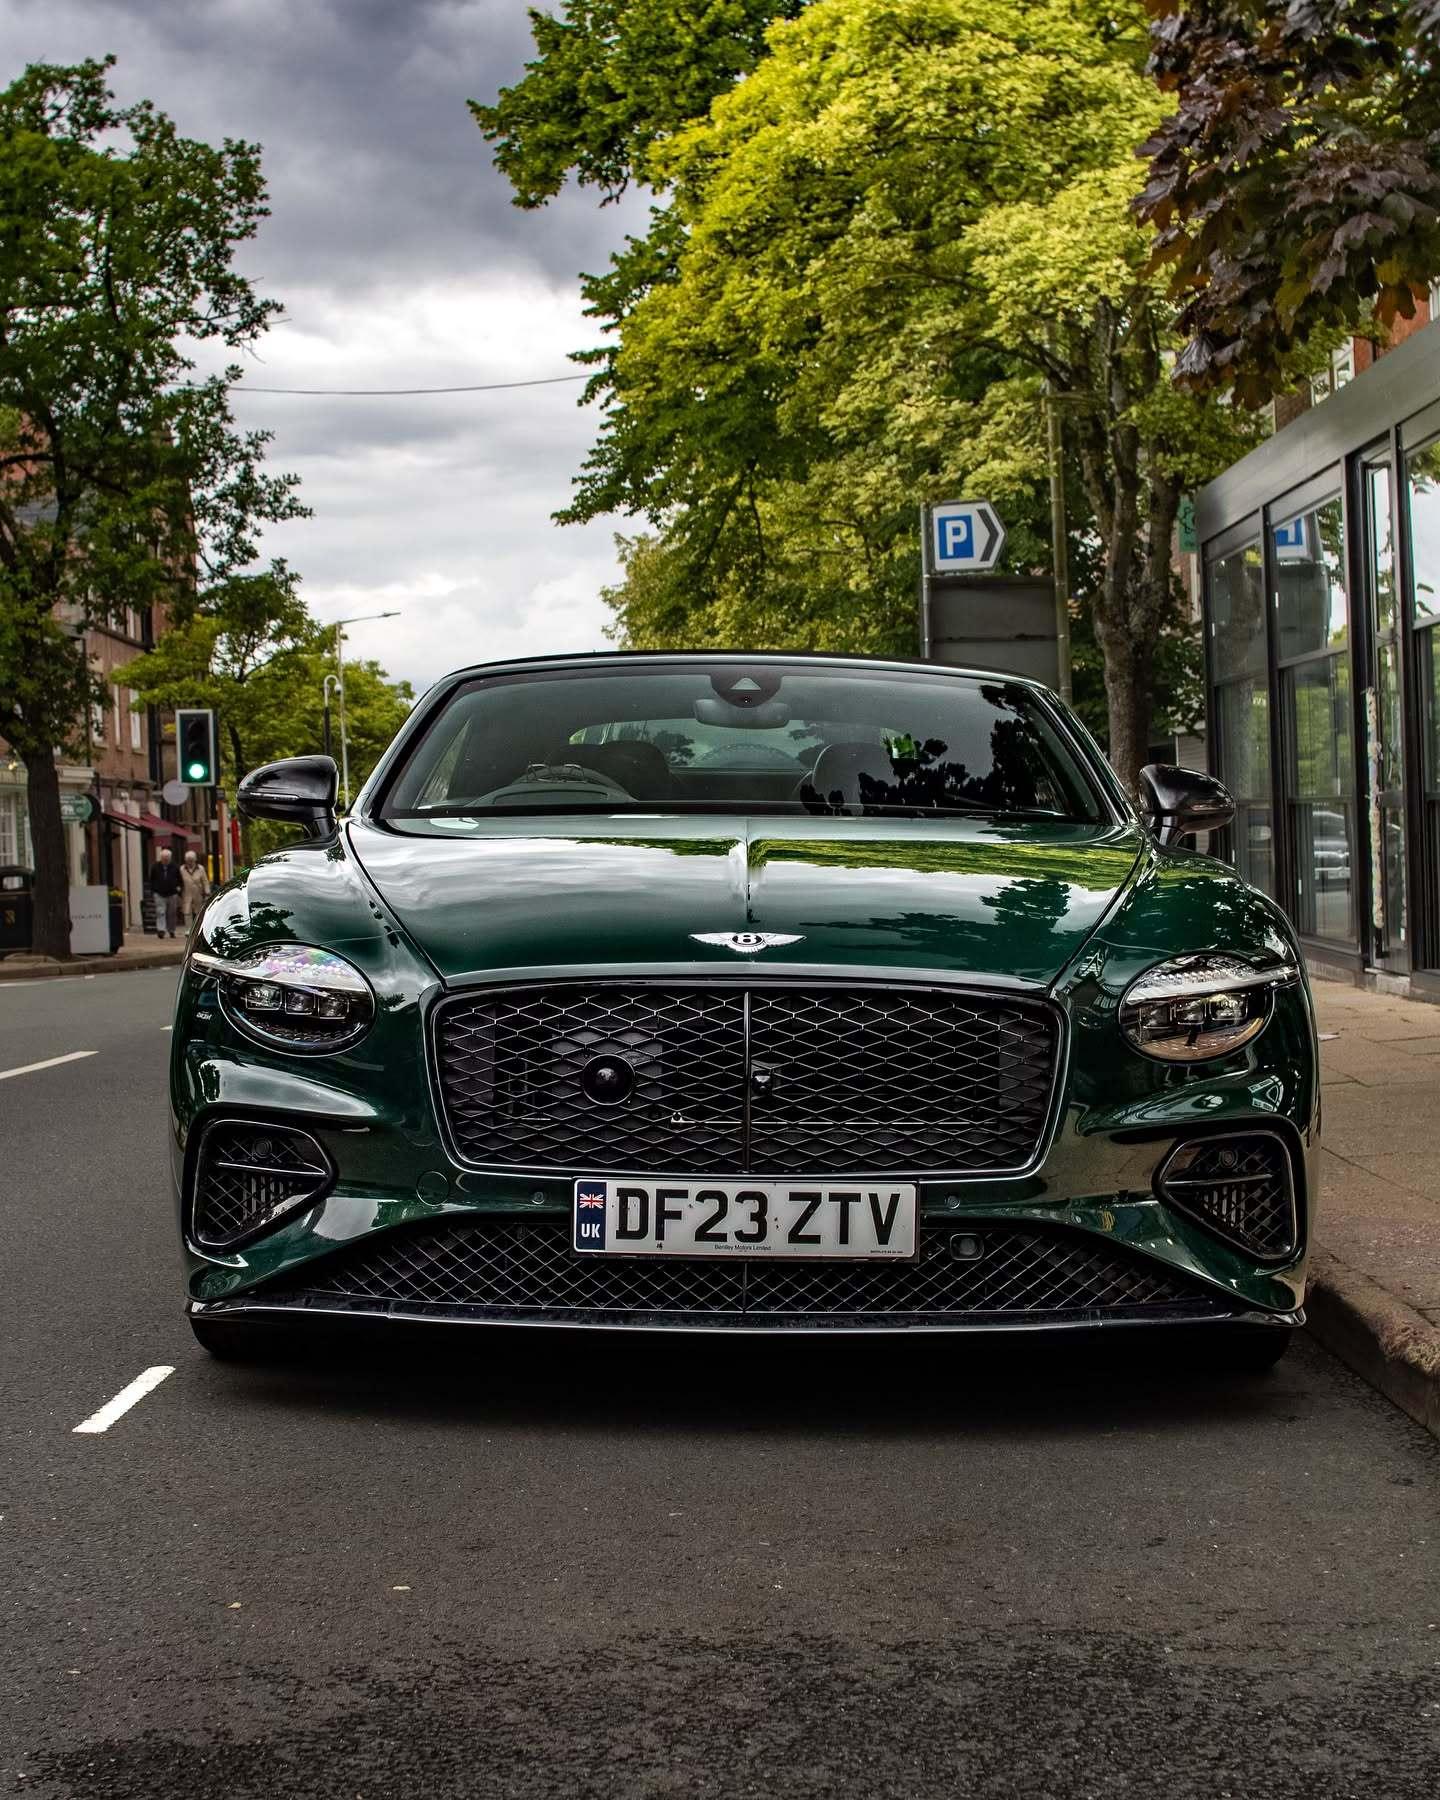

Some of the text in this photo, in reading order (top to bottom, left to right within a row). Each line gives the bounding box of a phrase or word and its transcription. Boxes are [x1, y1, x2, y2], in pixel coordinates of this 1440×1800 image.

[945, 520, 968, 557] P
[581, 1223, 601, 1238] UK
[615, 1187, 901, 1246] DF23 ZTV
